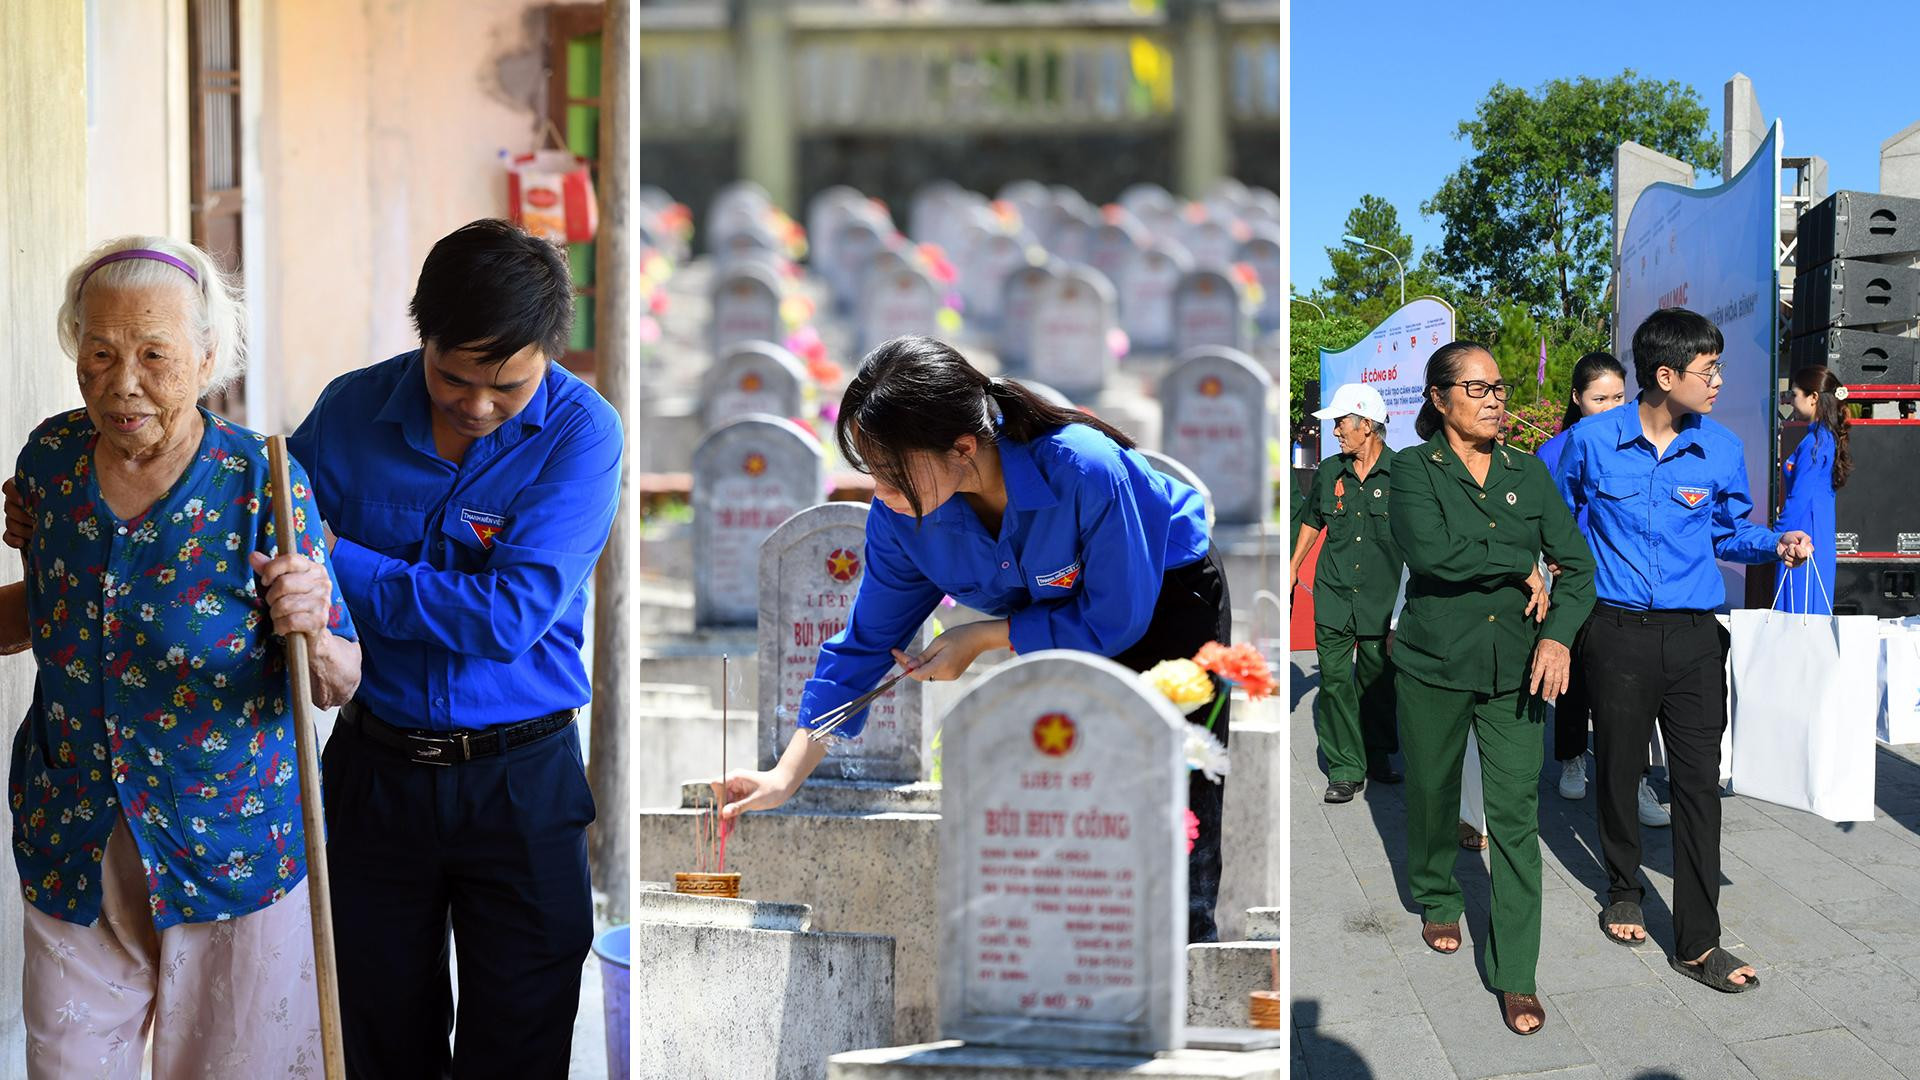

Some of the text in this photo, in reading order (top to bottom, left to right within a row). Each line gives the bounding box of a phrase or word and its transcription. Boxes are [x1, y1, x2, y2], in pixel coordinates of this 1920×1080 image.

[1369, 368, 1386, 382] CÔNG
[1388, 364, 1397, 380] BỐ
[1026, 810, 1067, 837] HUY
[1073, 806, 1131, 840] CÔNG
